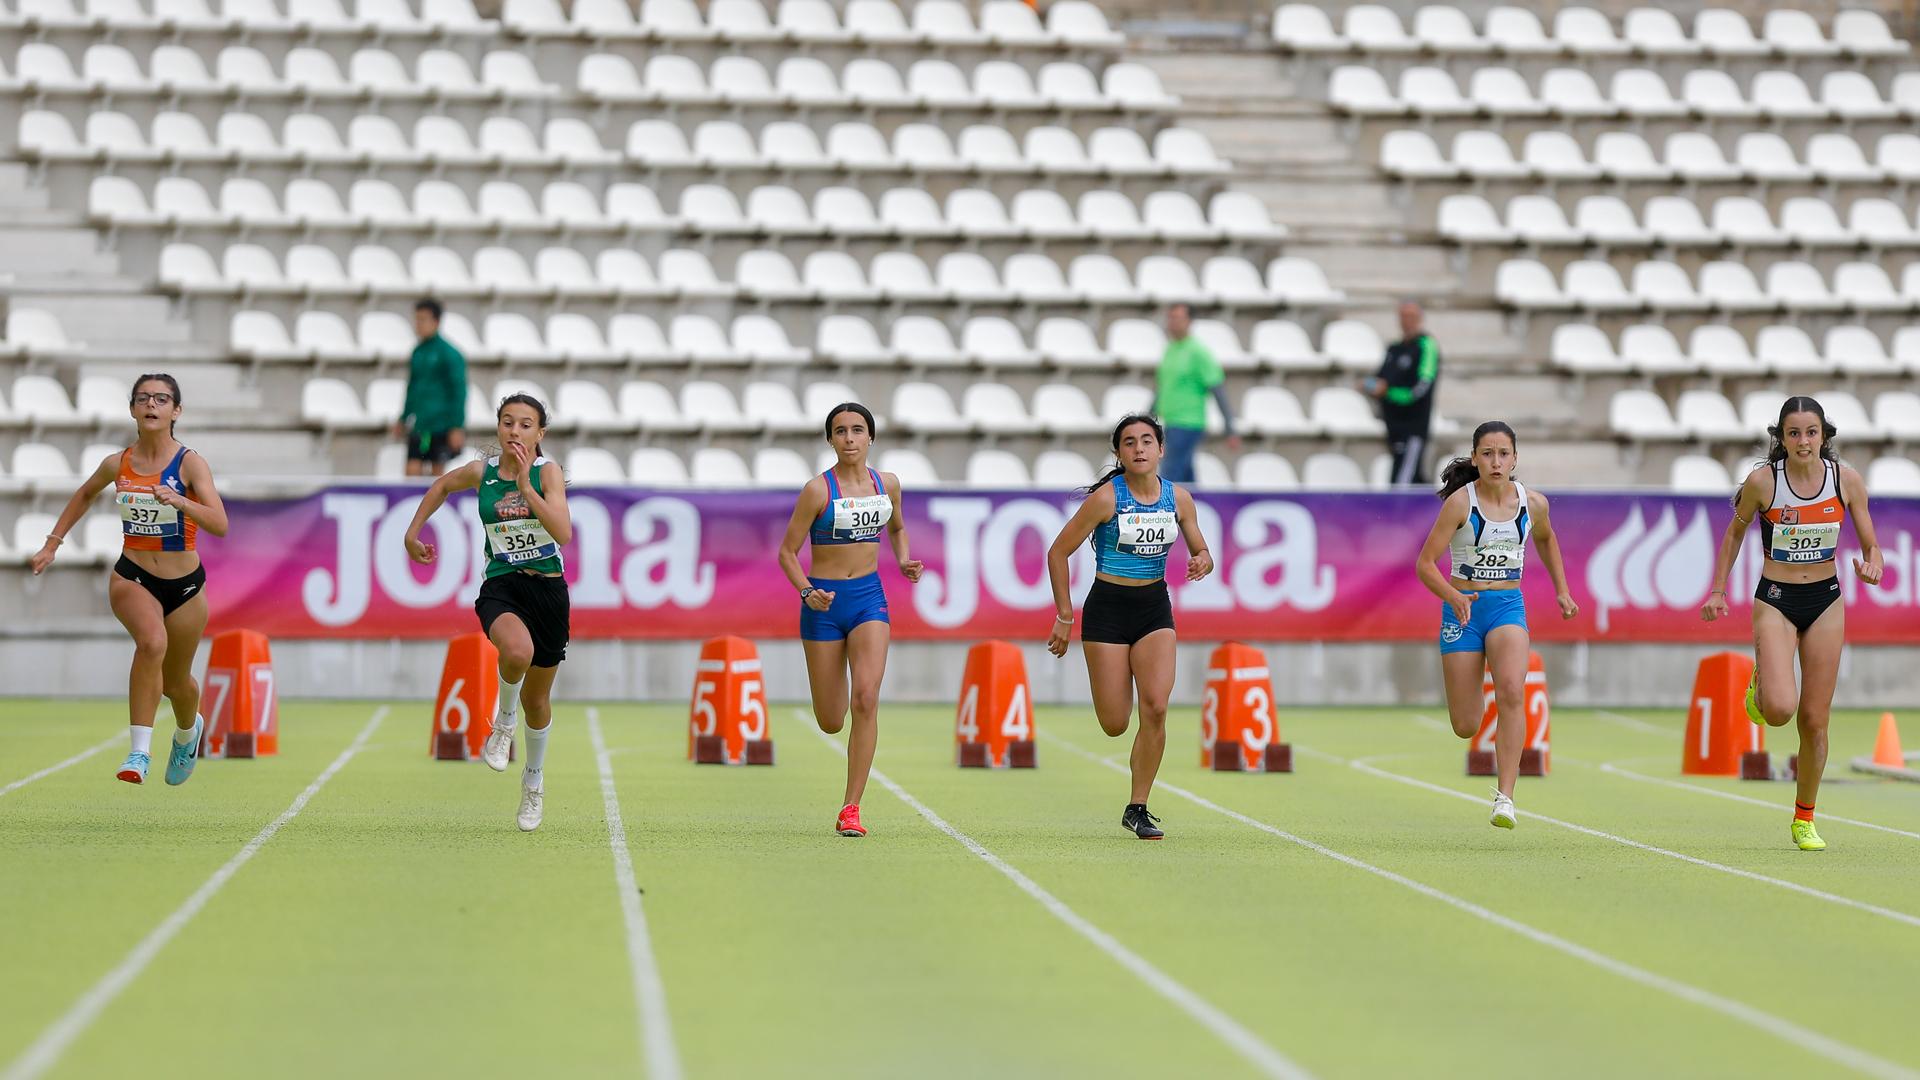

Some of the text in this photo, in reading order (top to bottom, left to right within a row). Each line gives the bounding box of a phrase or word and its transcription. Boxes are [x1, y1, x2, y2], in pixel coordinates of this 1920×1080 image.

[130, 508, 159, 523] 337
[505, 533, 536, 551] 354
[851, 511, 880, 527] 304
[1135, 528, 1165, 543] 204
[1789, 537, 1821, 550] 303
[1798, 527, 1832, 535] Iberdrola
[1474, 553, 1508, 567] 282
[208, 674, 231, 737] 7
[255, 668, 273, 732] 7
[440, 678, 471, 733] 6
[692, 681, 717, 736] 5
[739, 680, 765, 740] 5
[958, 684, 980, 743] 4
[1001, 684, 1029, 742] 4
[1202, 688, 1218, 748] 3
[1242, 686, 1273, 750] 3
[1529, 690, 1549, 752] 2
[1697, 697, 1712, 759] 1
